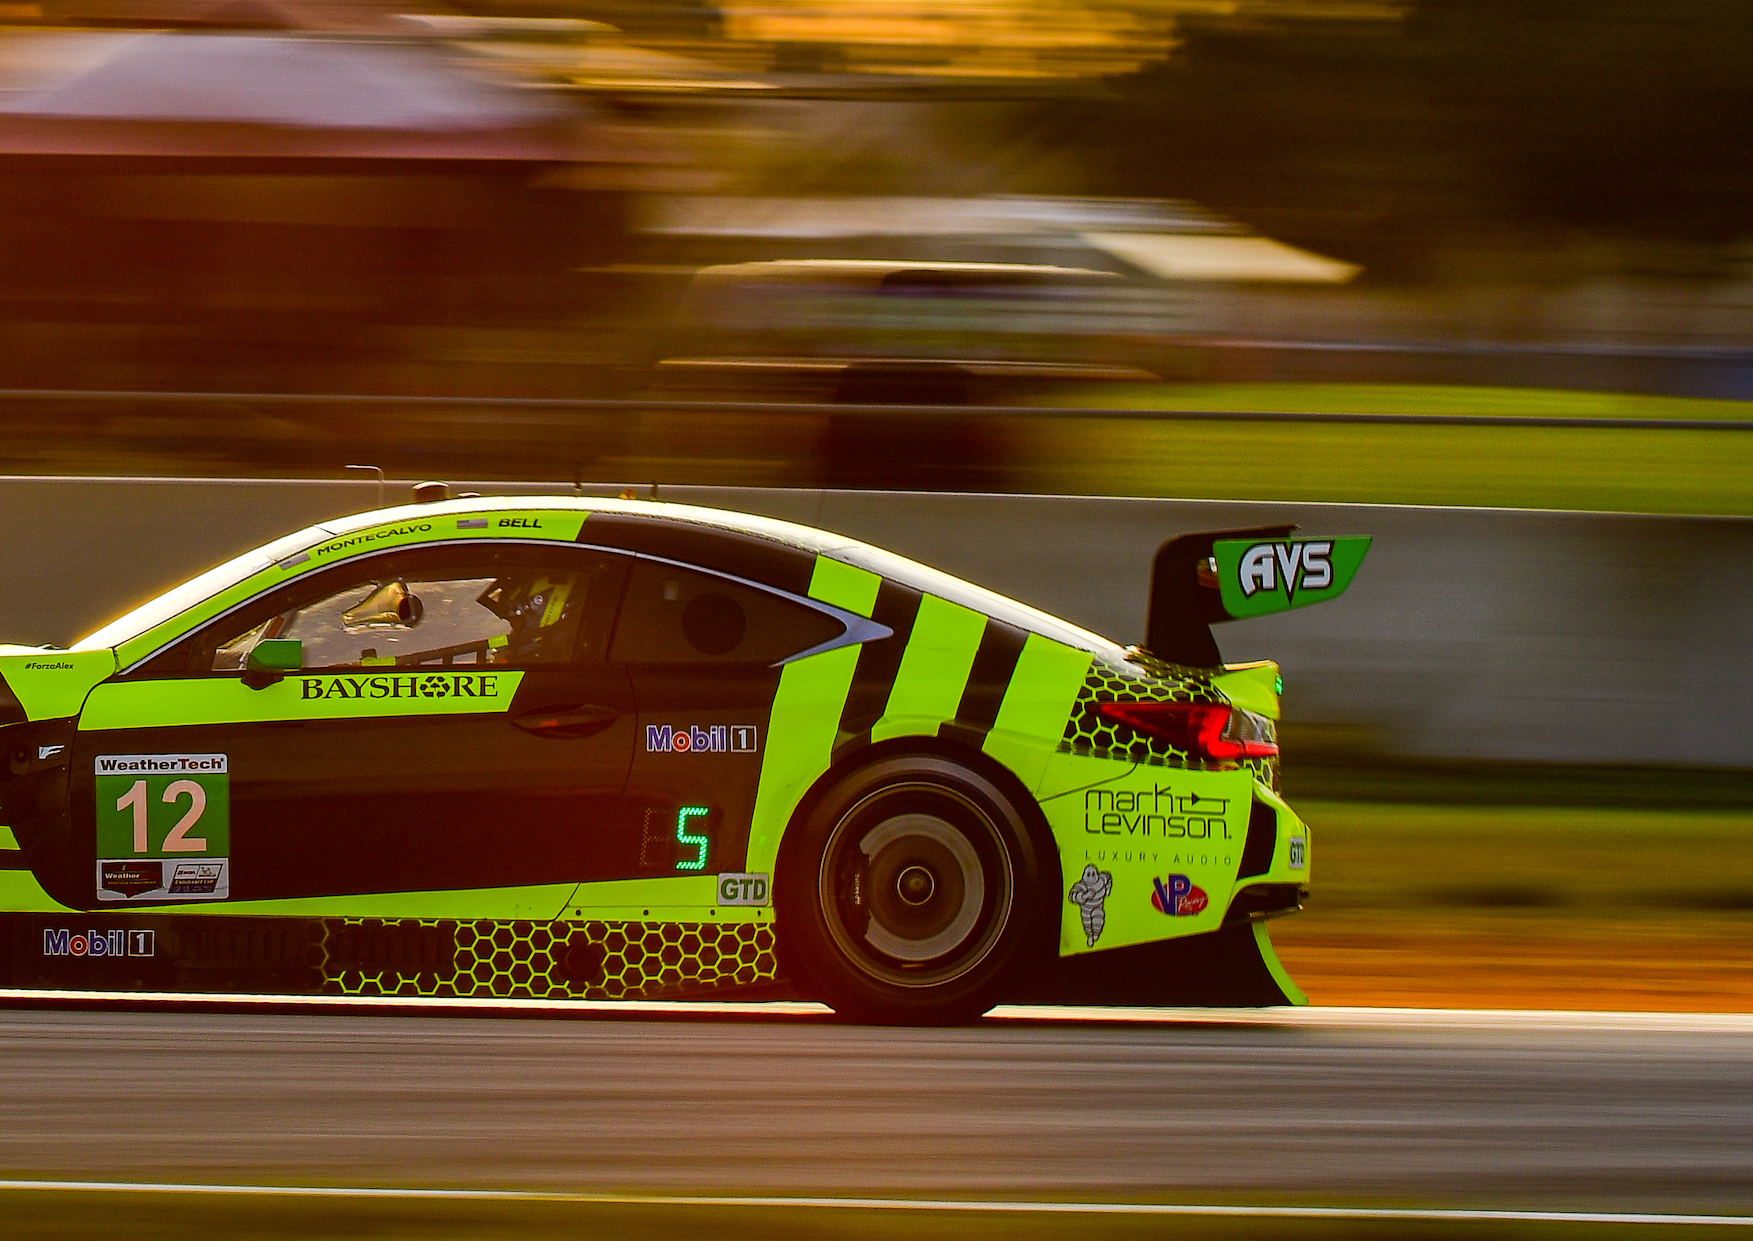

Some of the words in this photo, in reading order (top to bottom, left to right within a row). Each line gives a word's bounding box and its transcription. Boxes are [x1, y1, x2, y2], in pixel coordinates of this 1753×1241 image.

[498, 518, 543, 529] BELL
[317, 523, 432, 556] MONTECALVO
[1239, 540, 1333, 606] AVS
[25, 662, 74, 670] #ForzaAlex
[646, 725, 726, 753] Mobil
[1085, 782, 1174, 814] mark
[116, 779, 208, 853] 12
[675, 807, 709, 870] 5
[1085, 849, 1160, 863] LUXURY
[1173, 854, 1232, 866] AUDIO
[721, 878, 766, 901] GTD
[1152, 873, 1192, 916] VP
[43, 928, 124, 957] Mobil
